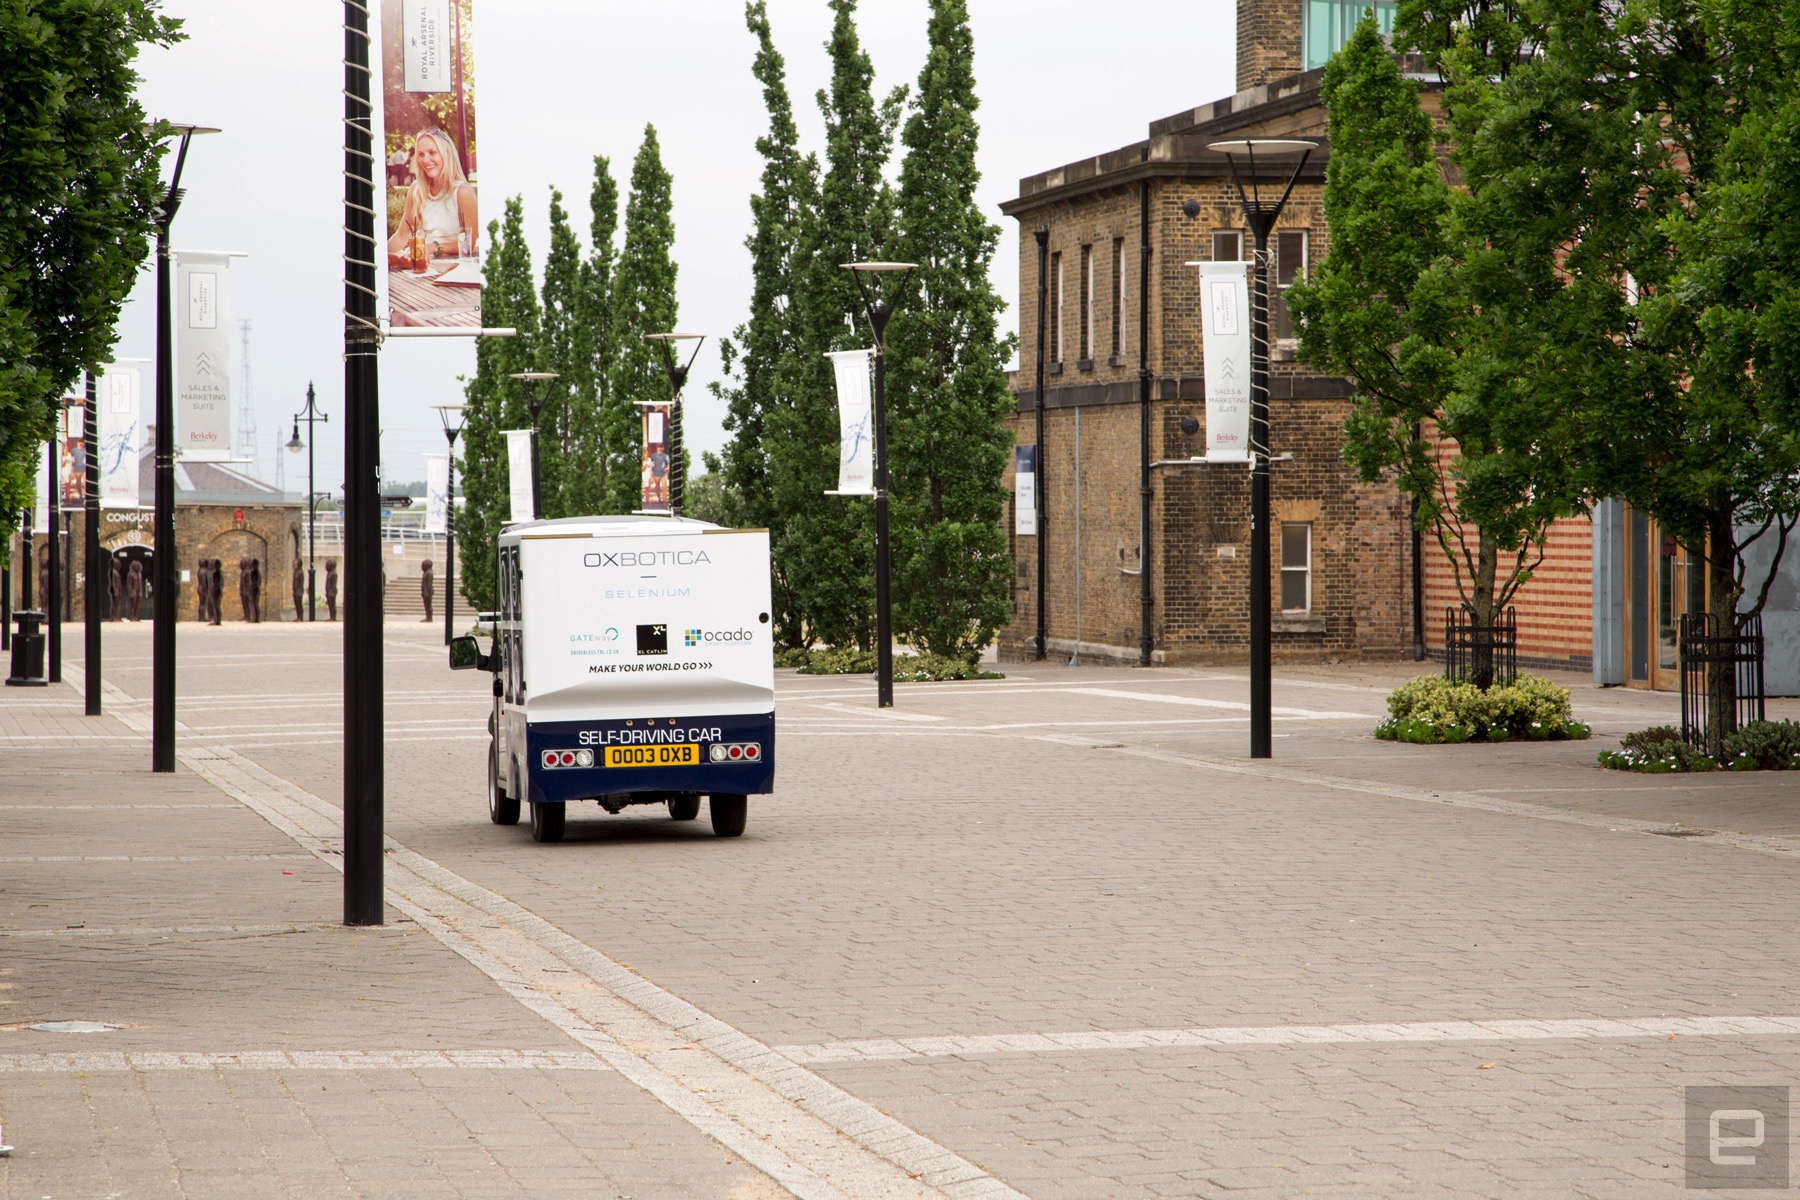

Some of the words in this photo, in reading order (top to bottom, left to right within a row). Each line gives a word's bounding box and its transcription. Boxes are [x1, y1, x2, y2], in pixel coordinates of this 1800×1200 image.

[420, 6, 428, 46] ARSENAL
[187, 384, 213, 392] SALES
[214, 384, 220, 392] &
[181, 393, 227, 401] MARKETING
[192, 402, 215, 410] SUITE
[1219, 405, 1238, 413] SUITE
[190, 431, 218, 442] Berkeley
[1216, 433, 1239, 443] Berkeley
[106, 512, 156, 523] CONGUST
[583, 550, 712, 568] OXBOTICA
[604, 587, 691, 599] SELENIUM
[653, 625, 667, 636] XL
[704, 627, 753, 642] ocado
[569, 634, 613, 643] GATEway
[588, 664, 617, 674] MAKE
[618, 663, 644, 673] YOUR
[646, 662, 681, 672] WORLD
[682, 662, 697, 671] GO
[578, 728, 685, 745] SELF-DRIVING
[688, 727, 722, 743] CAR
[660, 746, 692, 763] OXB
